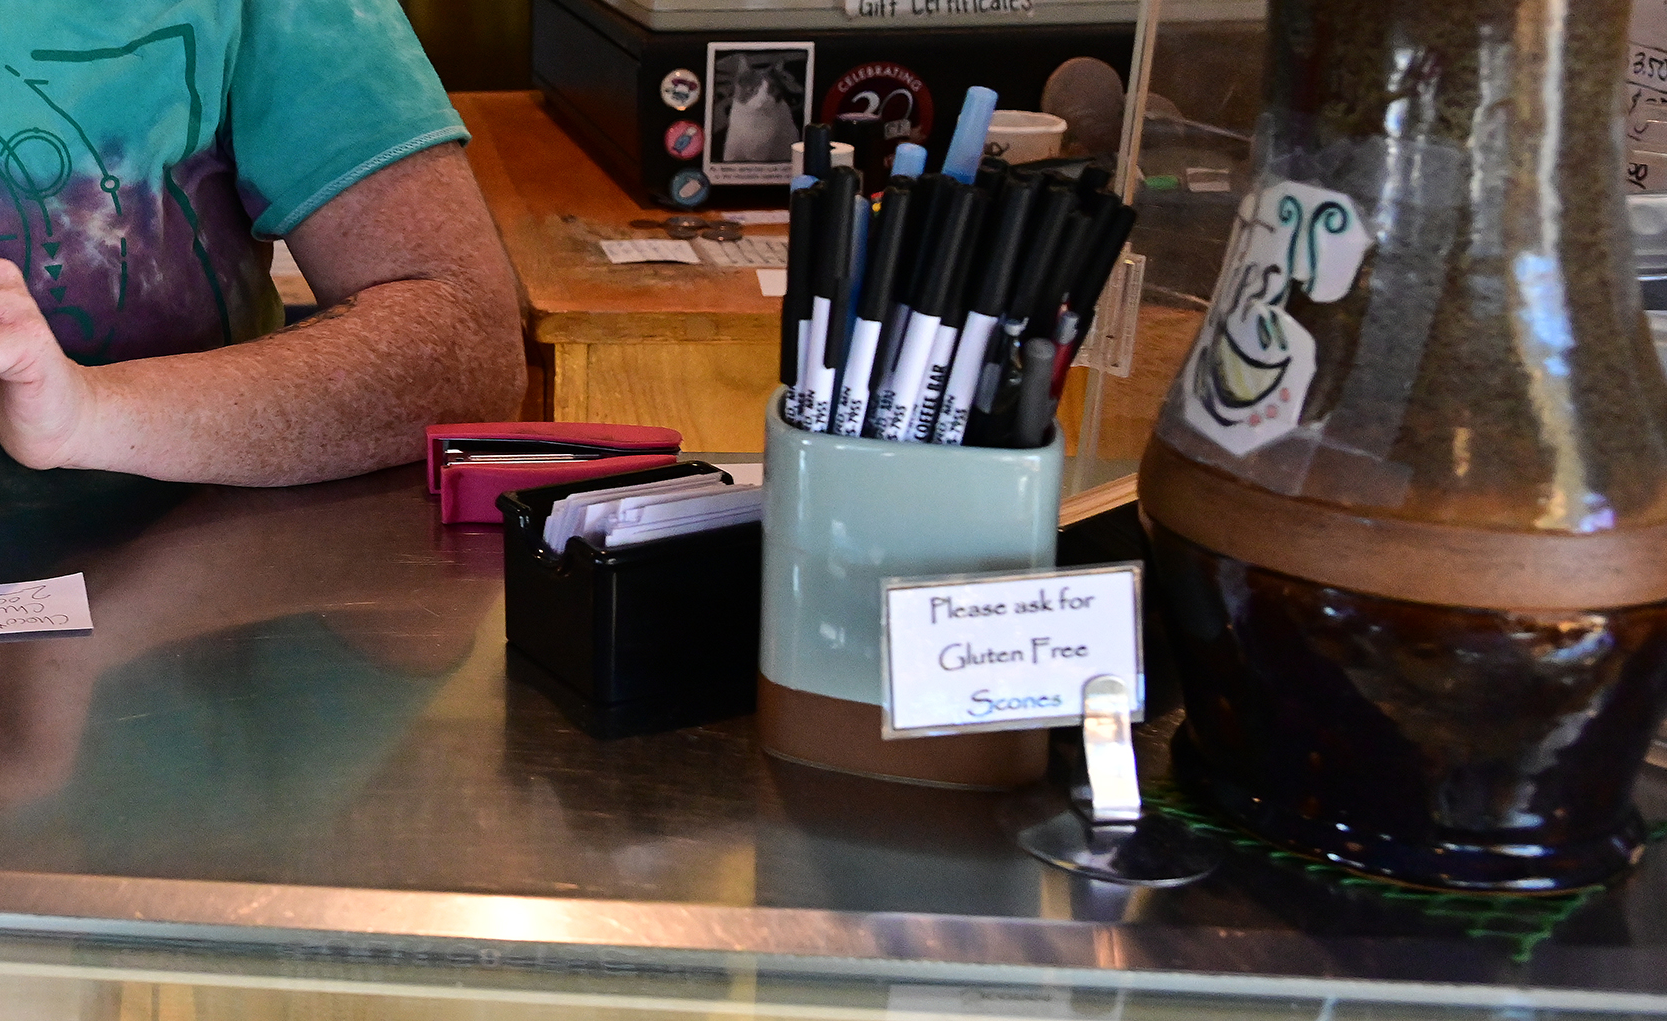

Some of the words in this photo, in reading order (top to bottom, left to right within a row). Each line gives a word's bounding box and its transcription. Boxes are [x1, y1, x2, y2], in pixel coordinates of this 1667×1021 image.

[837, 65, 923, 93] CELEBRATING
[927, 364, 946, 391] BAR
[930, 595, 1007, 624] Please
[1014, 589, 1053, 614] ask
[1058, 586, 1096, 610] for
[938, 642, 1025, 672] Gluten
[1031, 636, 1089, 665] Free
[967, 689, 1063, 718] Scones
